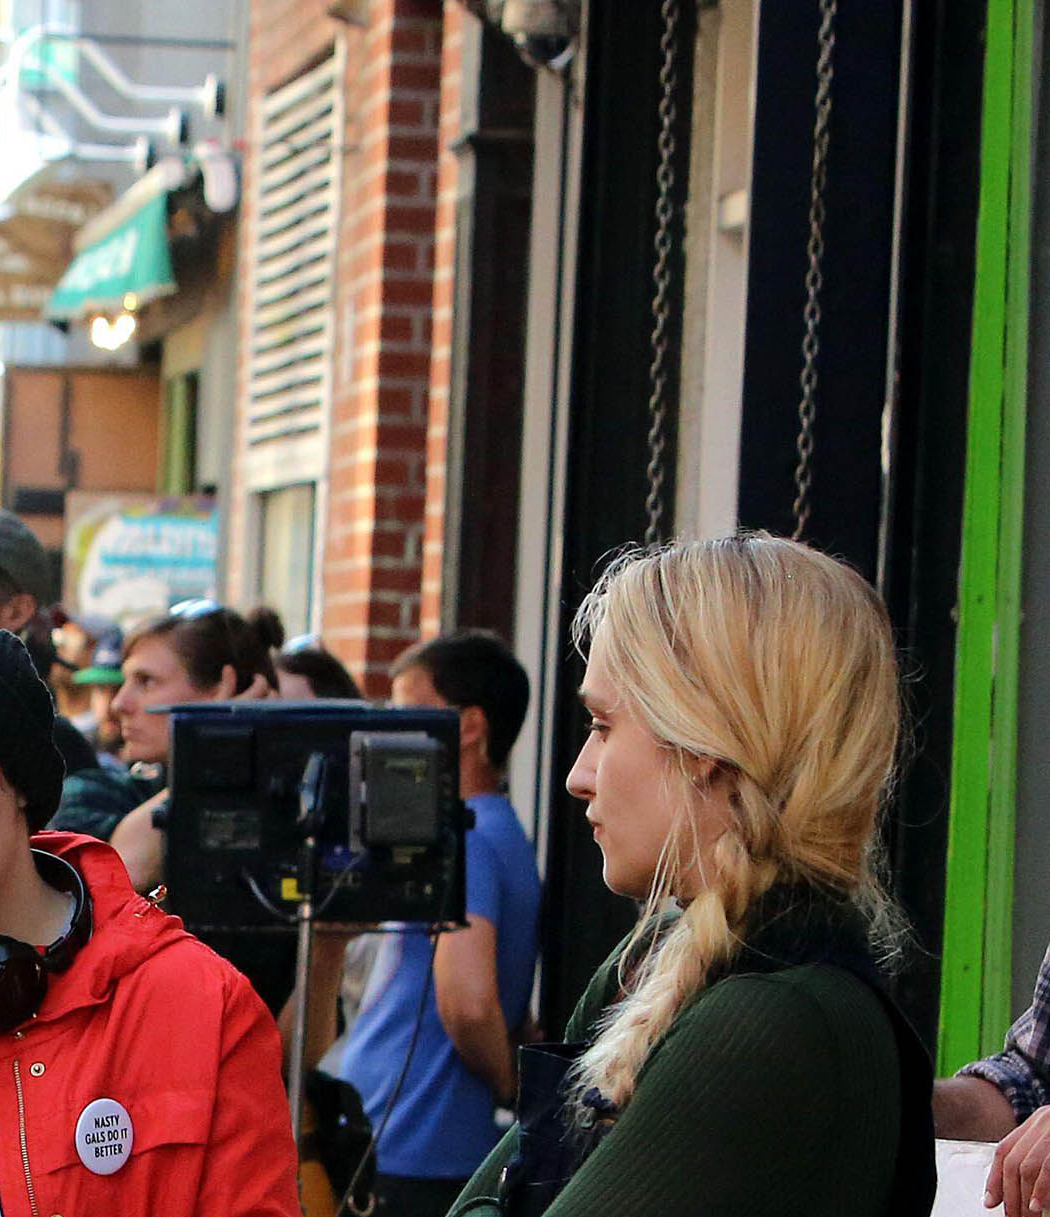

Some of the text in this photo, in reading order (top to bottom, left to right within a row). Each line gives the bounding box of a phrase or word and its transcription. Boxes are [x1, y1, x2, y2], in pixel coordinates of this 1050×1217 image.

[94, 1114, 120, 1128] NASTY
[85, 1128, 127, 1144] GALS DO IT
[95, 1144, 123, 1158] BETTER
